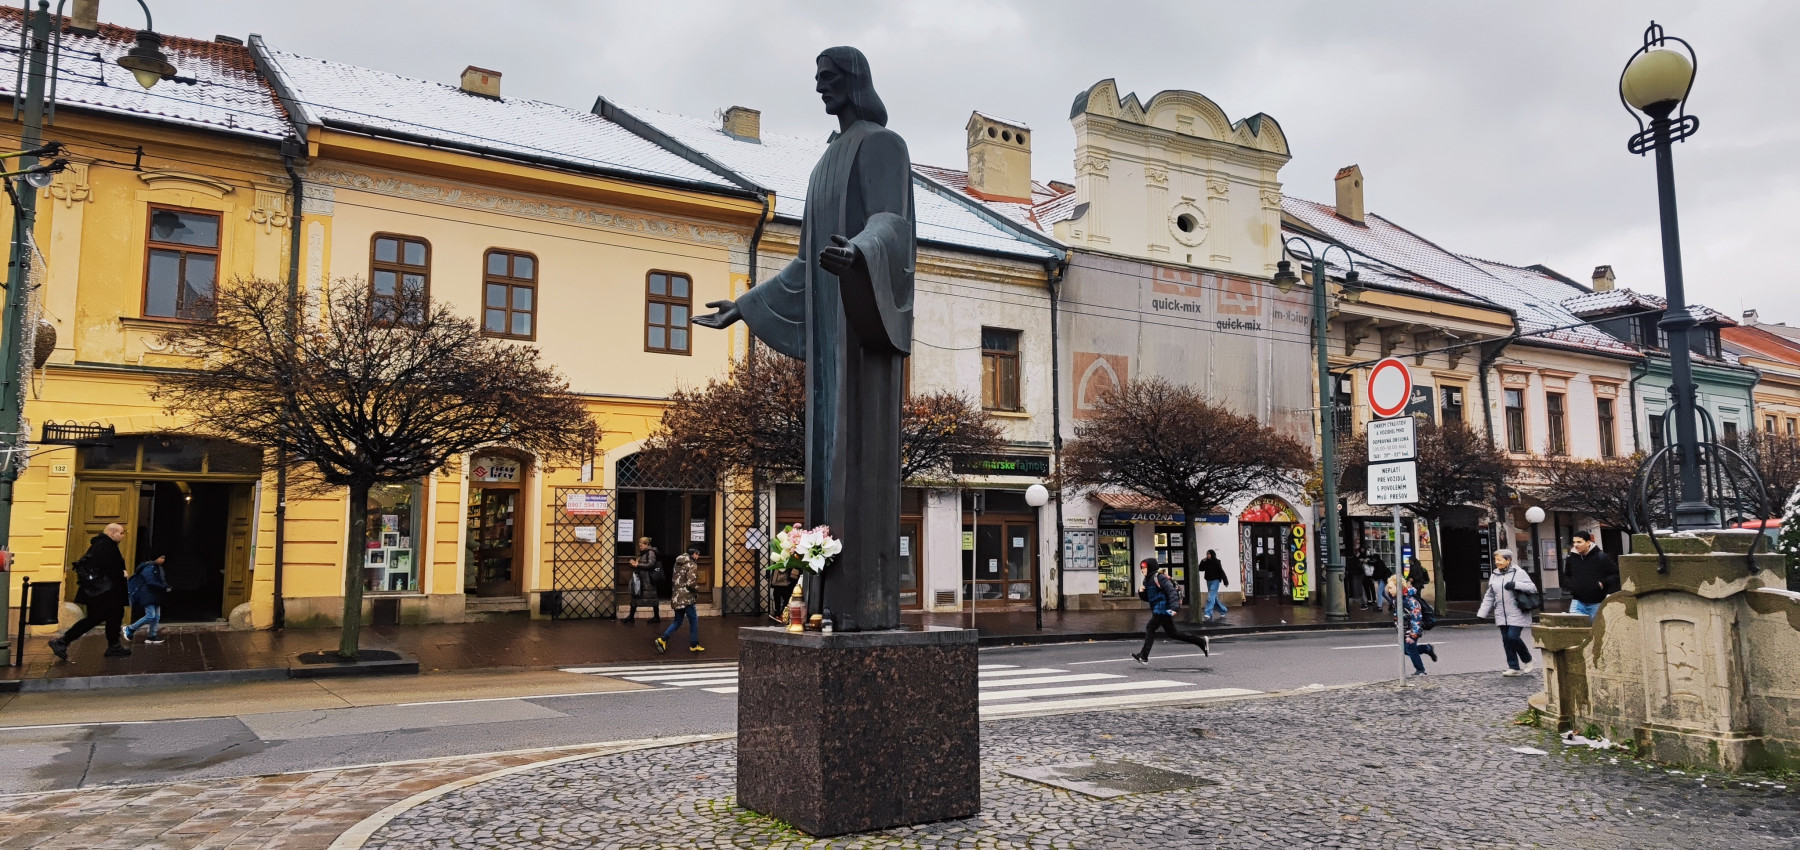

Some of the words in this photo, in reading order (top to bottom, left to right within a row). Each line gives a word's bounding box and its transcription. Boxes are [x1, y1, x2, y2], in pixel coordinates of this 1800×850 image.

[1152, 298, 1201, 314] quick-mix
[1216, 317, 1262, 333] quick-mix
[1382, 466, 1401, 474] NEPLATÍ
[1293, 526, 1306, 598] OVOCIE
